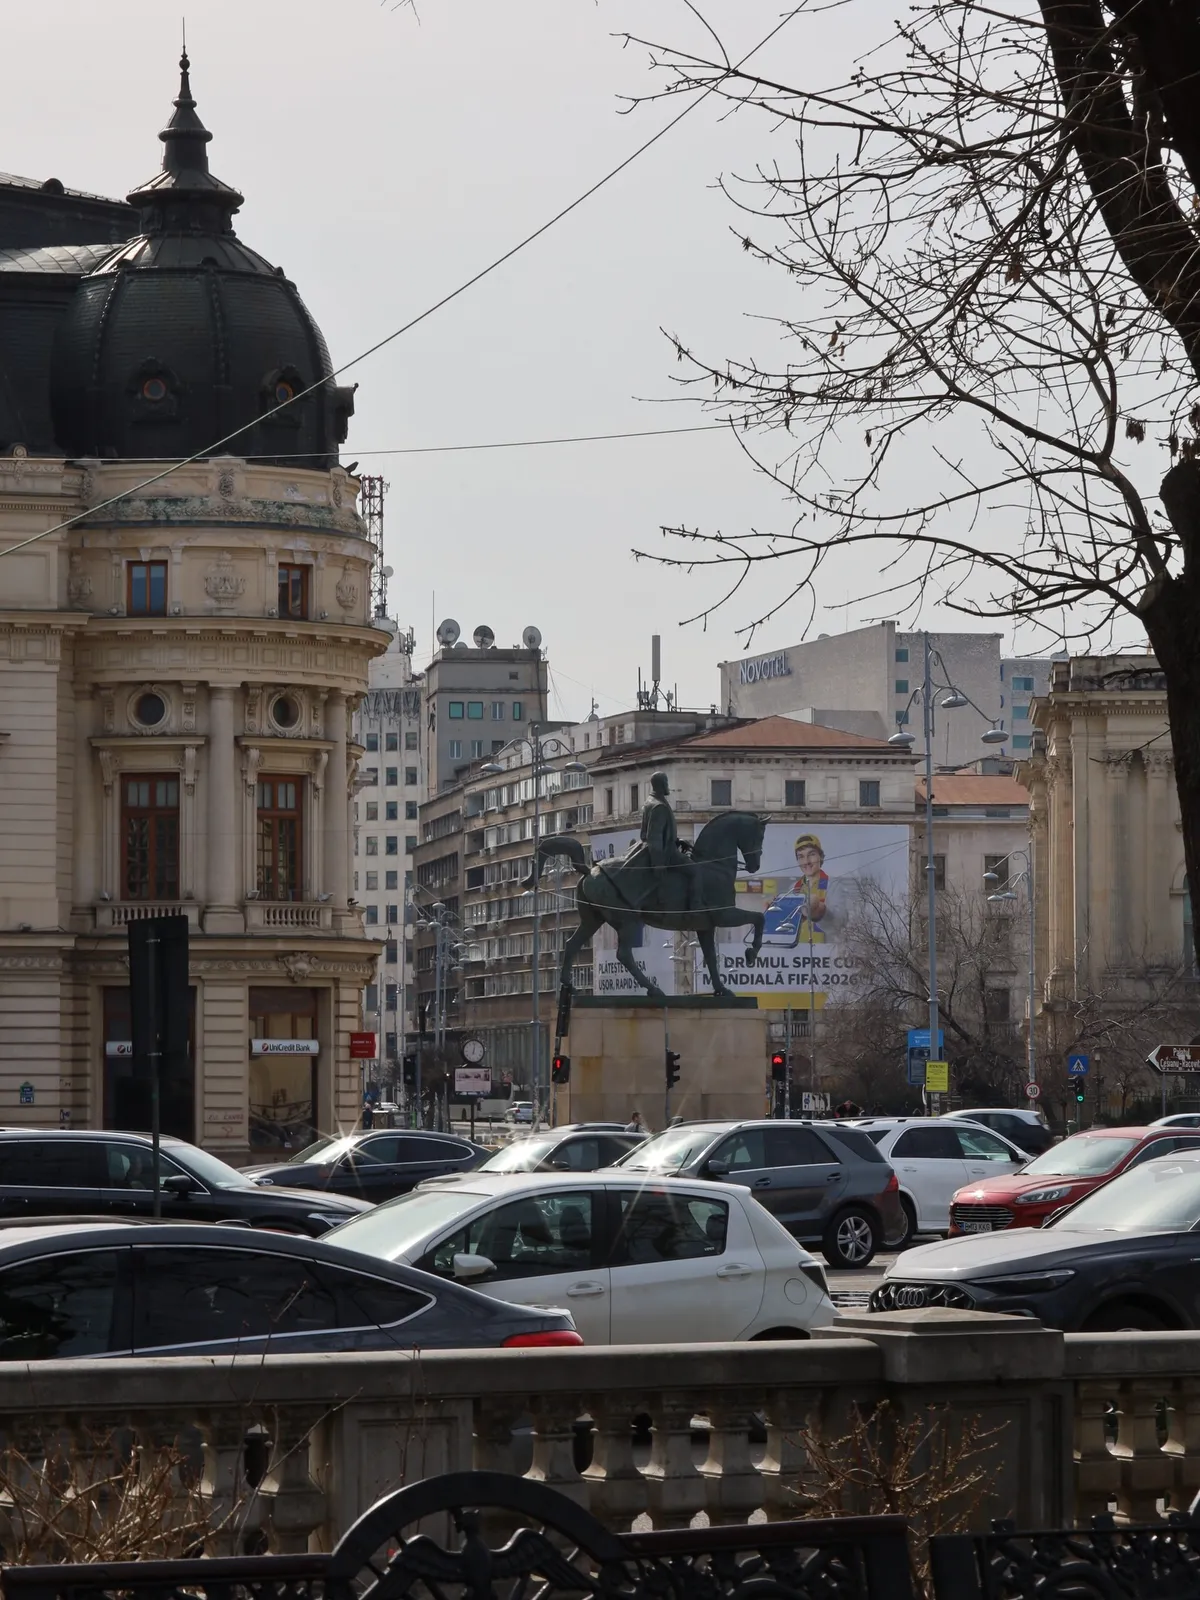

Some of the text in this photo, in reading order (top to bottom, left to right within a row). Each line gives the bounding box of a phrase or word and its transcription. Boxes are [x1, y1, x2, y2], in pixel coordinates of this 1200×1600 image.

[740, 651, 788, 684] NOVOTEL
[792, 956, 830, 969] SPRE
[616, 977, 632, 989] RAPID
[703, 971, 857, 985] MONDIALĂ FIFA 2026
[269, 1043, 311, 1052] UniCredit Bank
[1028, 1087, 1038, 1095] 30
